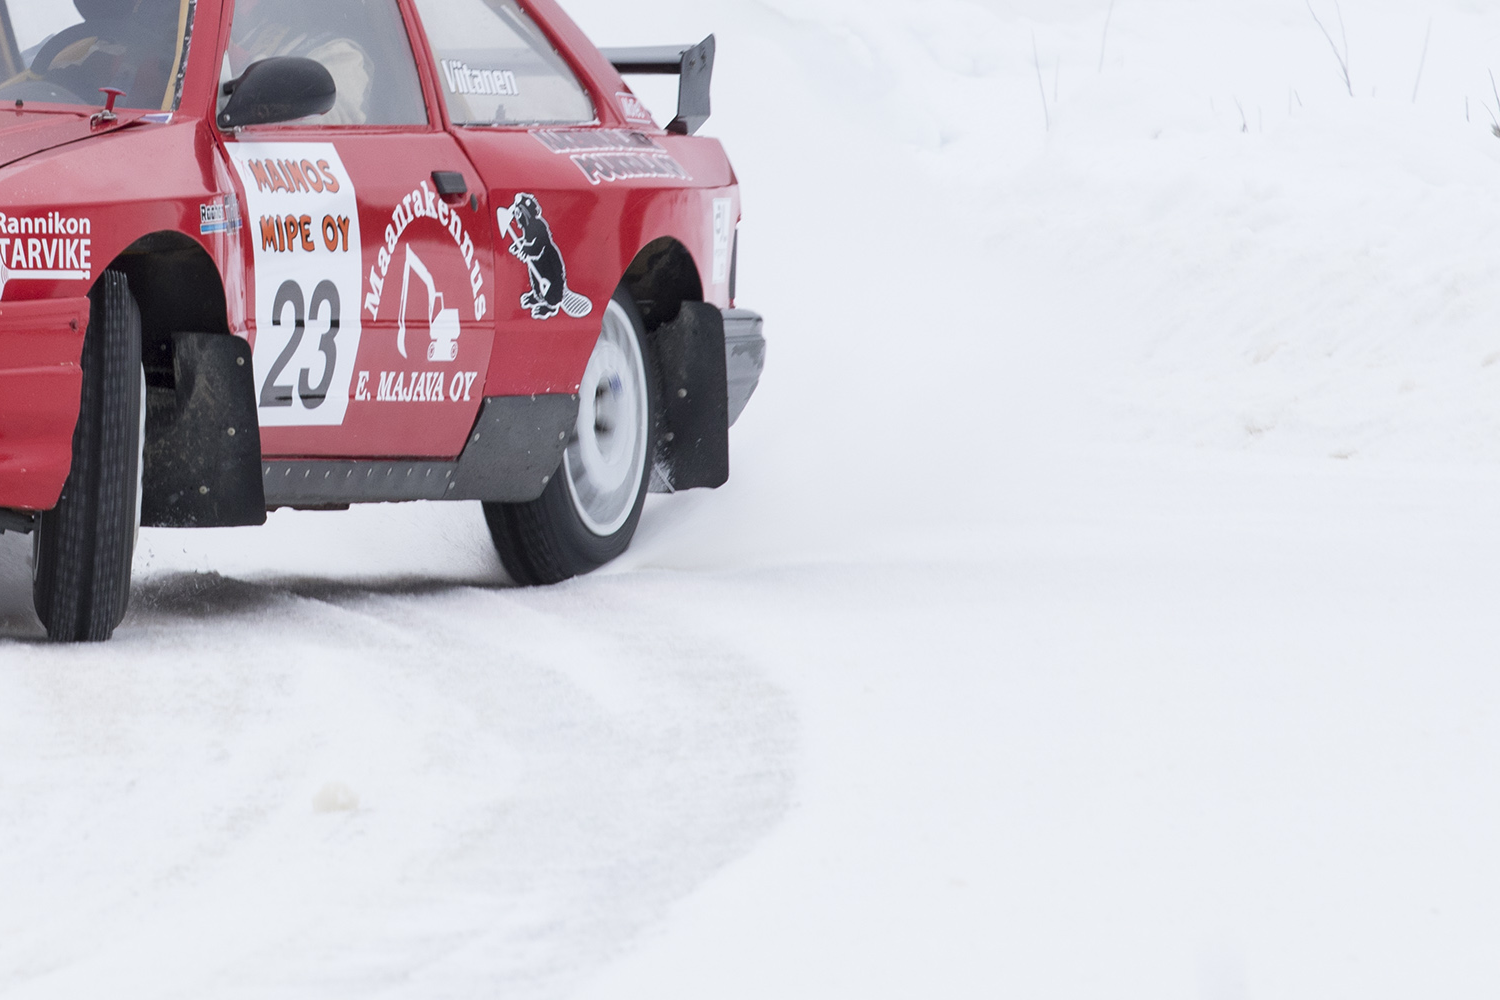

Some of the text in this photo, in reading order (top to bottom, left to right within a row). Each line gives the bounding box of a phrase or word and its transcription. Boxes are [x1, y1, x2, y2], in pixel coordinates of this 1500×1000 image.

[440, 59, 520, 96] Viitanen
[247, 157, 341, 194] MAINOS
[259, 213, 351, 253] MIPE OY
[363, 180, 487, 322] Maanrakennus
[258, 278, 342, 411] 23
[354, 370, 479, 403] E. MAJAVA OY
